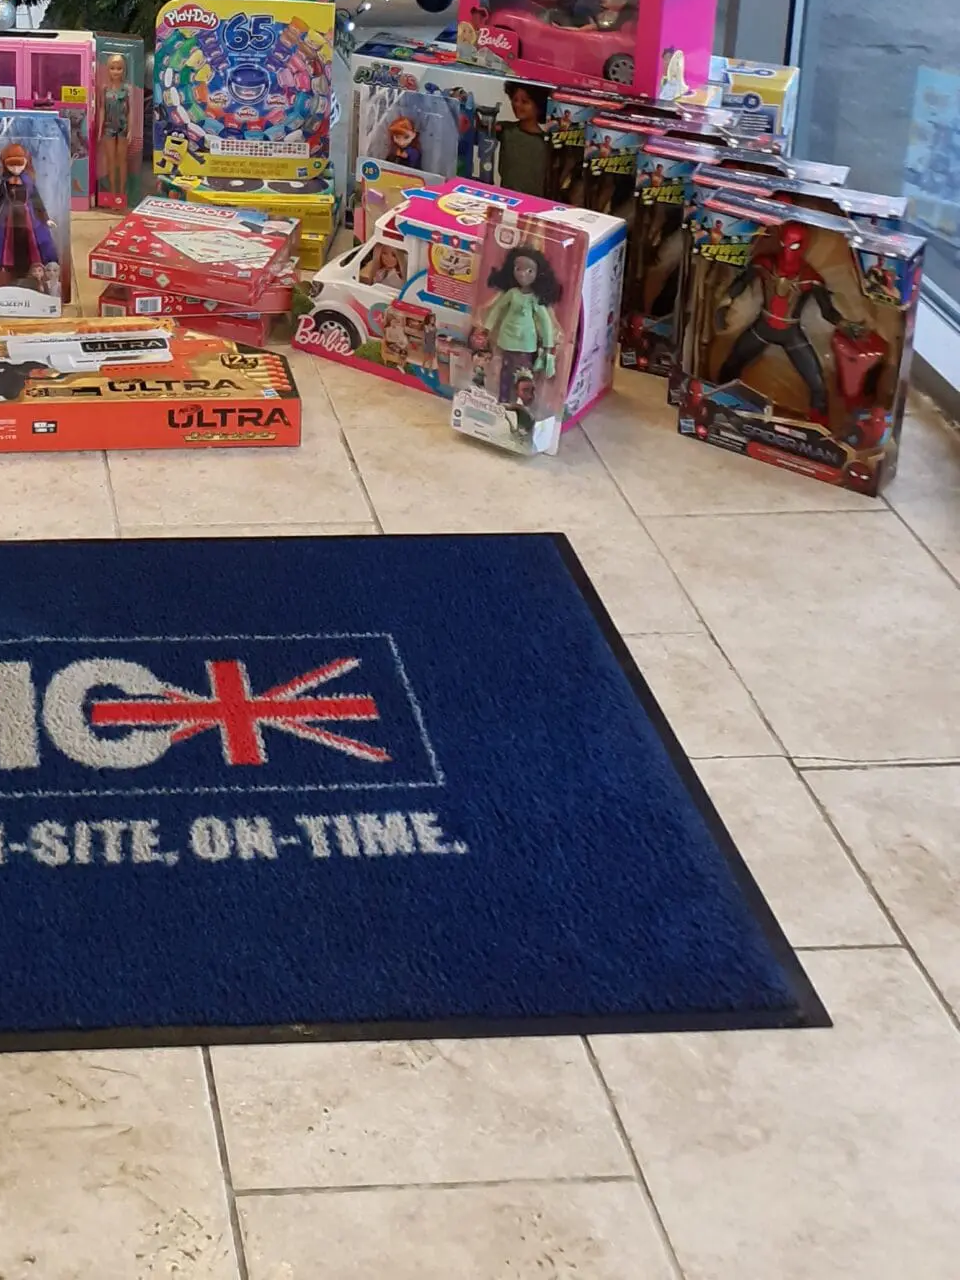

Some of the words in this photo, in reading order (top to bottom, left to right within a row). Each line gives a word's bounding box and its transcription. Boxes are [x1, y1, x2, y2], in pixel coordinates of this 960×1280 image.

[222, 12, 276, 52] 65
[477, 27, 512, 51] Barbie
[147, 200, 237, 219] MONOPOLY
[84, 339, 165, 352] ULTRA
[295, 314, 355, 357] Barbie
[107, 378, 245, 393] ULTRA
[167, 406, 292, 430] ULTRA
[189, 811, 471, 864] ON-TIME.
